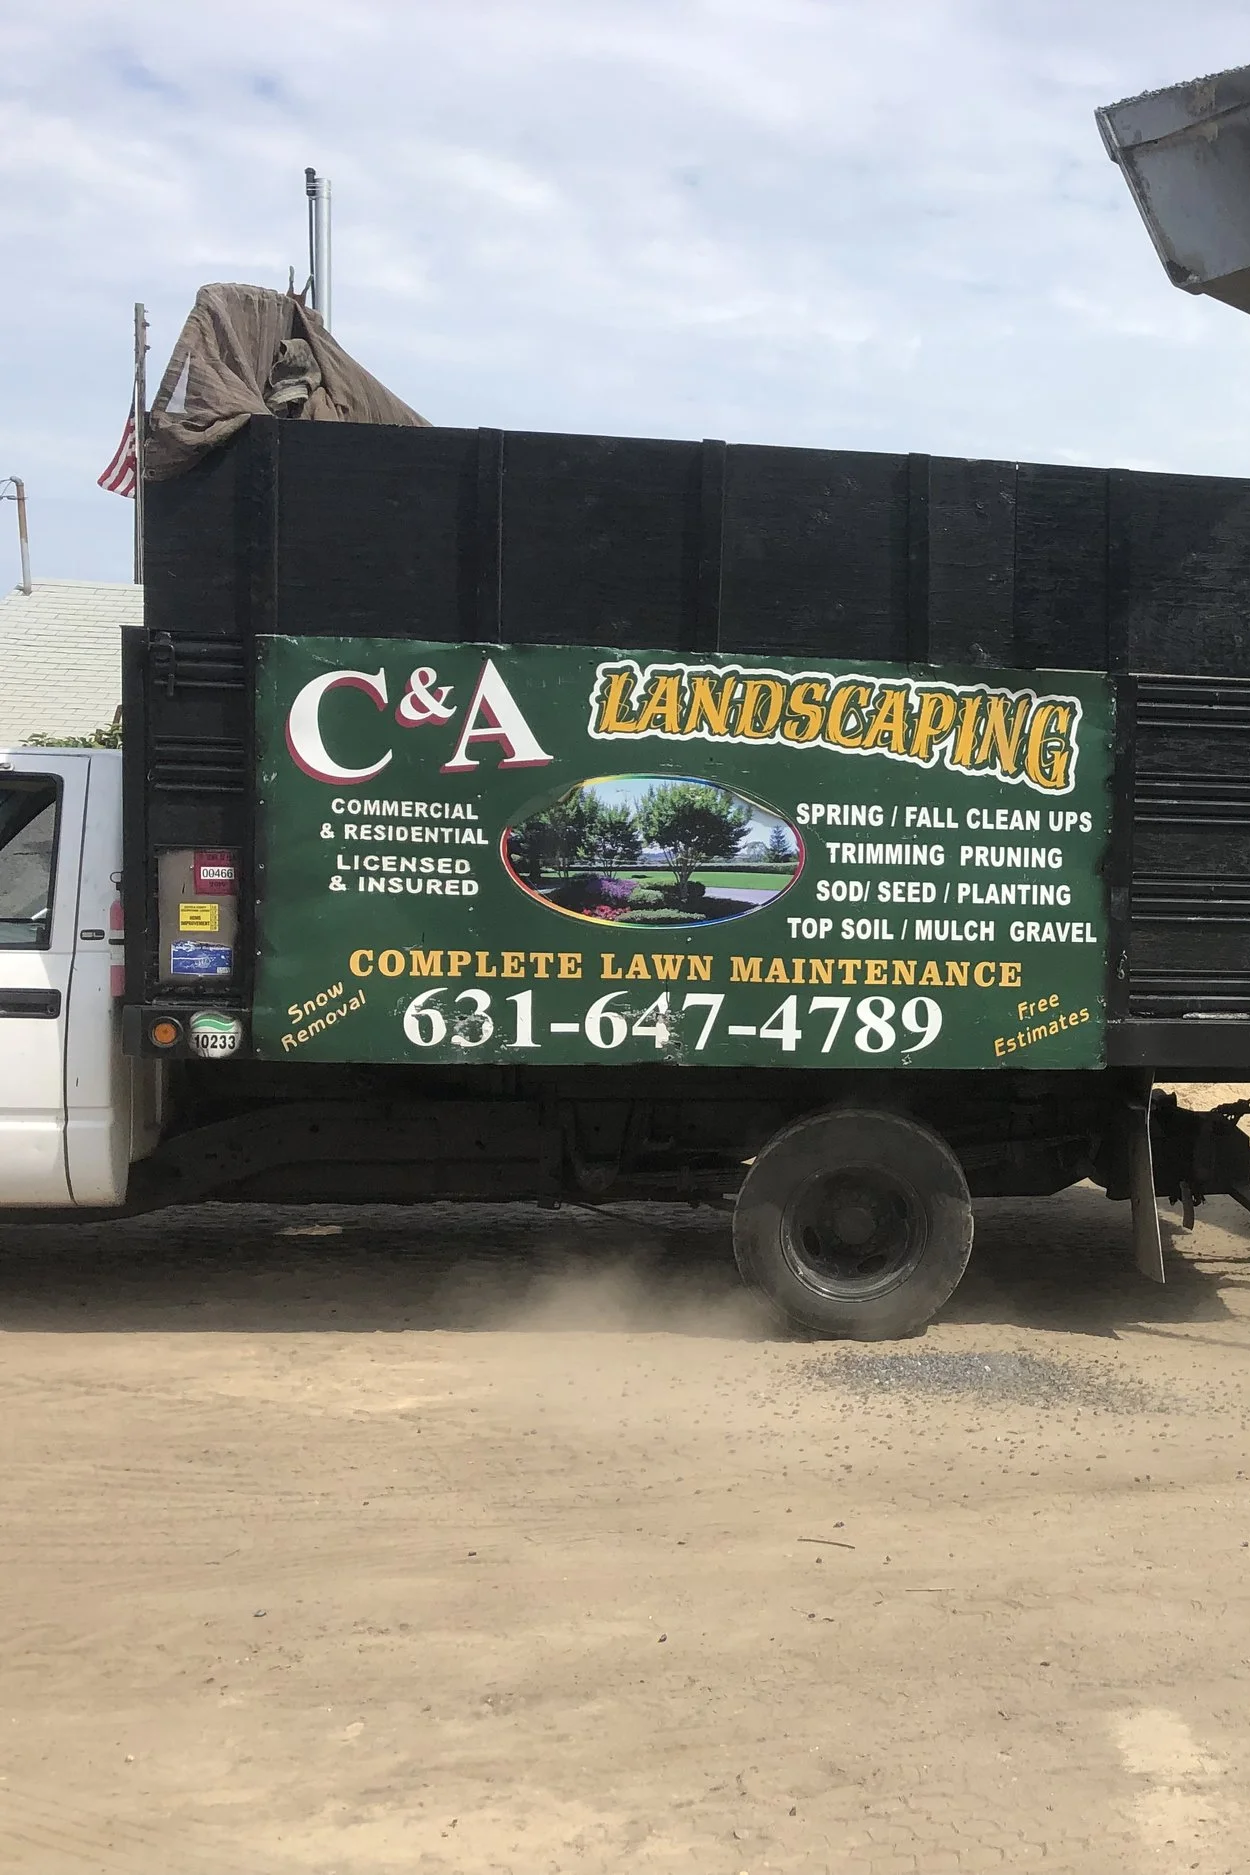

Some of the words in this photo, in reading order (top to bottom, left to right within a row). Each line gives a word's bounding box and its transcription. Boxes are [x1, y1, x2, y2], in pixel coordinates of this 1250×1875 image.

[590, 661, 1081, 795] LANDSCAPING
[331, 798, 479, 820] COMMERCIAL
[796, 803, 884, 827] SPRING
[905, 806, 959, 829] FALL
[966, 808, 1041, 831] CLEAN
[1049, 811, 1093, 833] UPS
[319, 823, 335, 839] &
[344, 824, 489, 845] RESIDENTIAL
[336, 854, 471, 875] LICENSED
[825, 842, 945, 866] TRIMMING
[960, 845, 1063, 869] PRUNING
[202, 868, 234, 879] 00466
[328, 876, 347, 893] &
[358, 876, 479, 897] INSURED
[877, 881, 937, 903] SEED
[957, 883, 1072, 906] PLANTING
[787, 917, 834, 939] TOP
[841, 918, 894, 940] SOIL
[915, 919, 996, 942] MULCH
[1009, 921, 1098, 943] GRAVEL
[348, 949, 584, 979] COMPLETE
[600, 953, 714, 981] LAWN
[729, 956, 1024, 987] MAINTENANCE
[286, 981, 344, 1025] Snow
[1017, 993, 1060, 1021] Free
[280, 989, 367, 1052] Removal
[402, 987, 943, 1055] 631-647-4789
[992, 1005, 1091, 1058] Estimates
[194, 1034, 236, 1050] 10233
